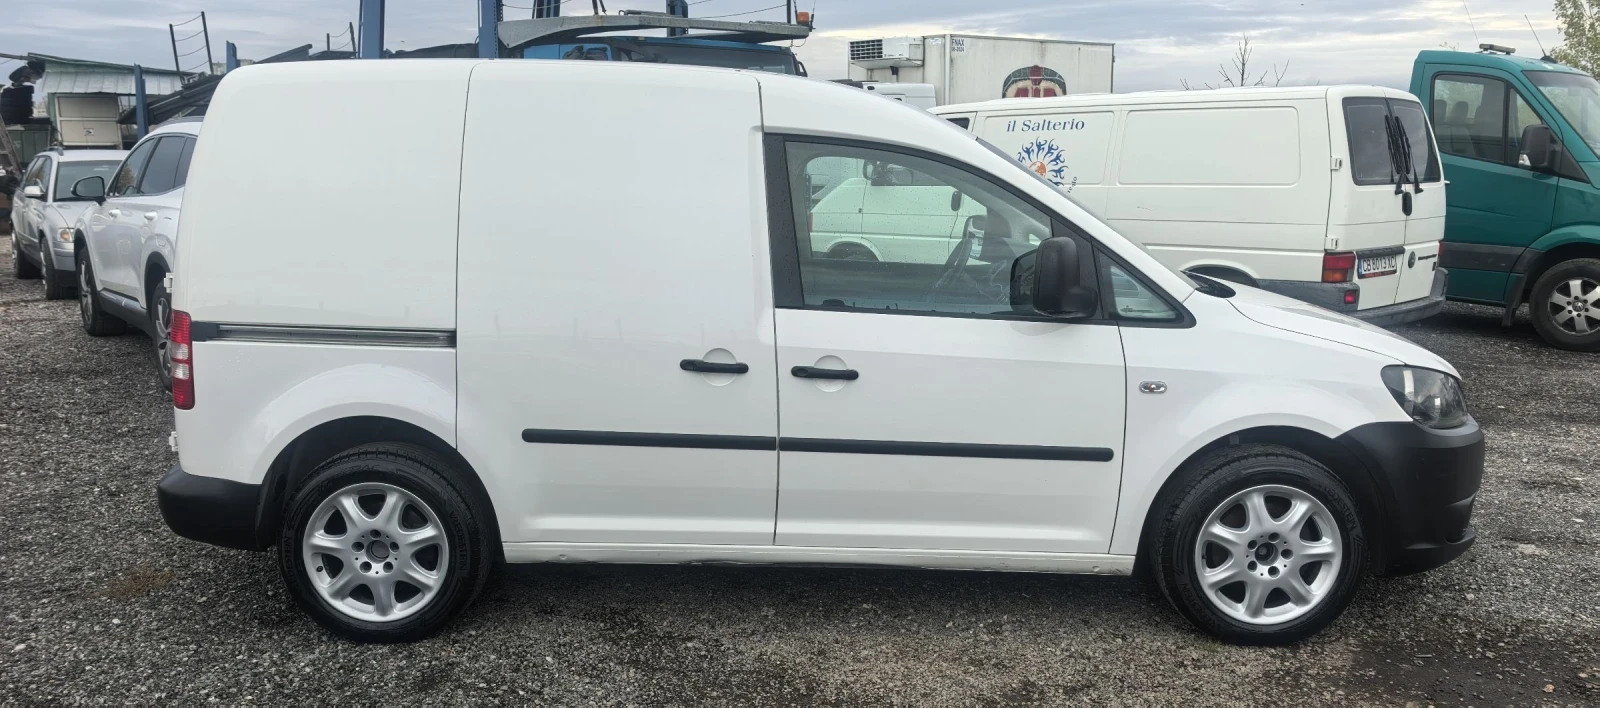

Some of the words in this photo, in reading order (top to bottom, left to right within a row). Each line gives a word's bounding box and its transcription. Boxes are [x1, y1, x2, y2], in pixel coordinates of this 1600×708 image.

[951, 38, 965, 46] FNAX
[1006, 120, 1016, 132] il
[1021, 118, 1085, 132] Salterio
[1362, 258, 1372, 272] CB
[1372, 256, 1387, 271] 8013
[1387, 255, 1395, 269] XC
